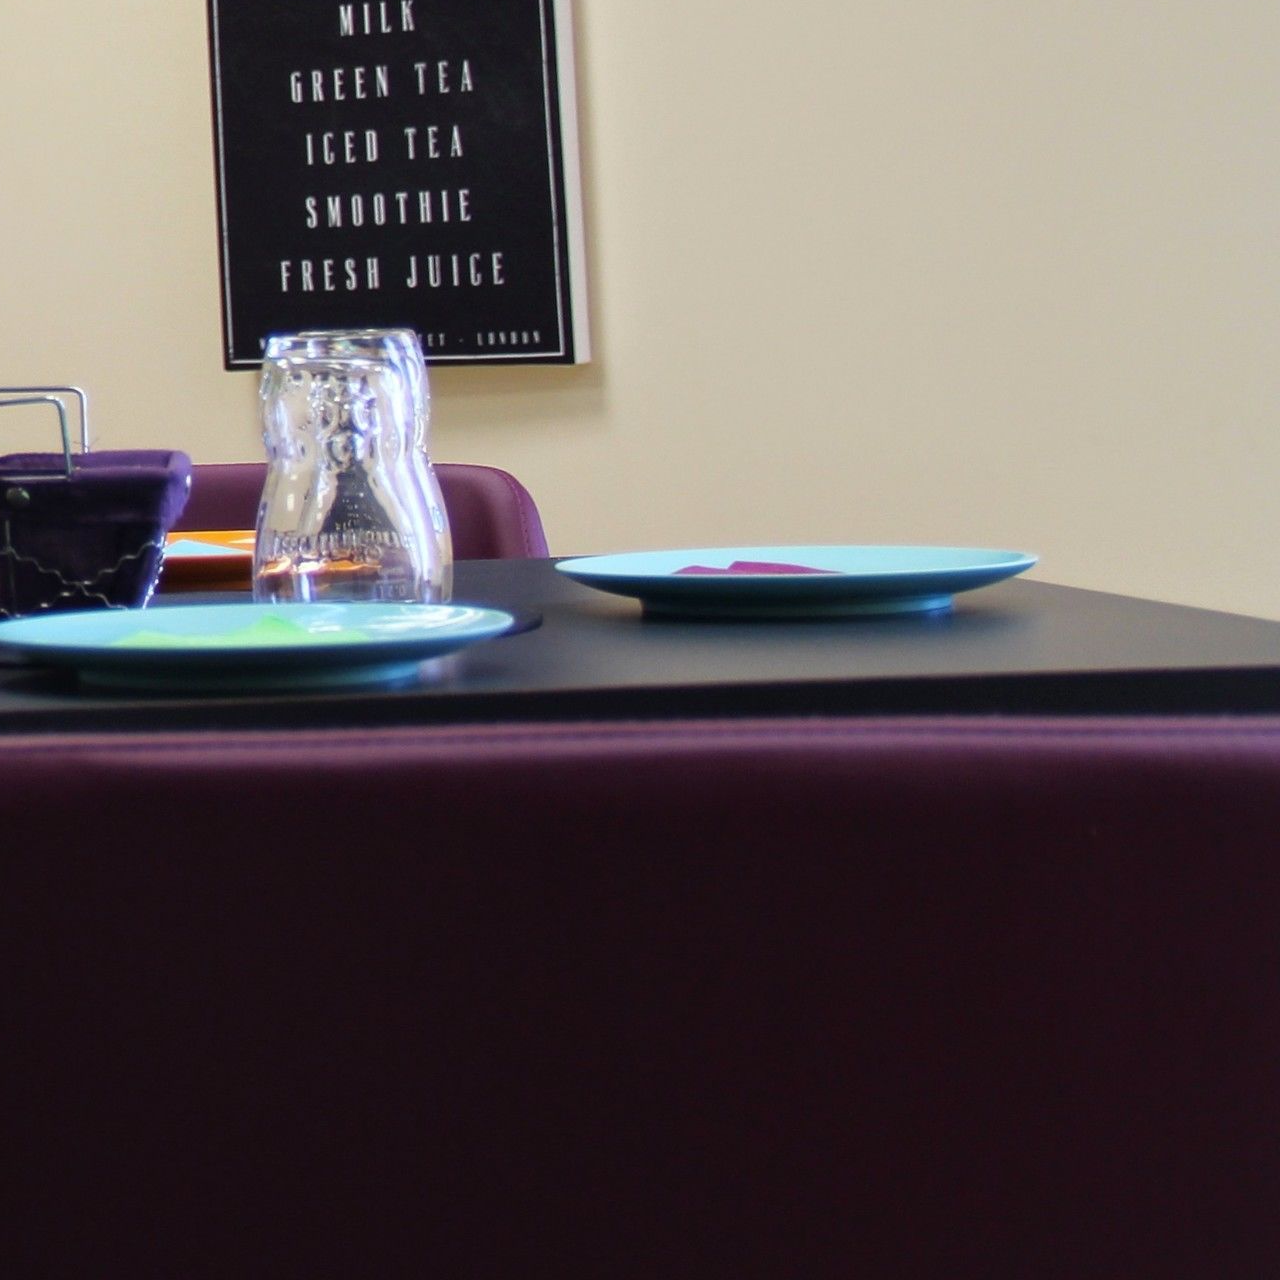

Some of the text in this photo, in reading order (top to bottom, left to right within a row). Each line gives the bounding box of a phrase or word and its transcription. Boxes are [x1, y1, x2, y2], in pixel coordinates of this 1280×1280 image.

[339, 0, 414, 36] MILK
[290, 60, 473, 103] GREEN TEA
[306, 125, 462, 165] ICED TEA
[305, 189, 471, 228] SMOOTHIE
[281, 252, 504, 292] FRESH JUICE
